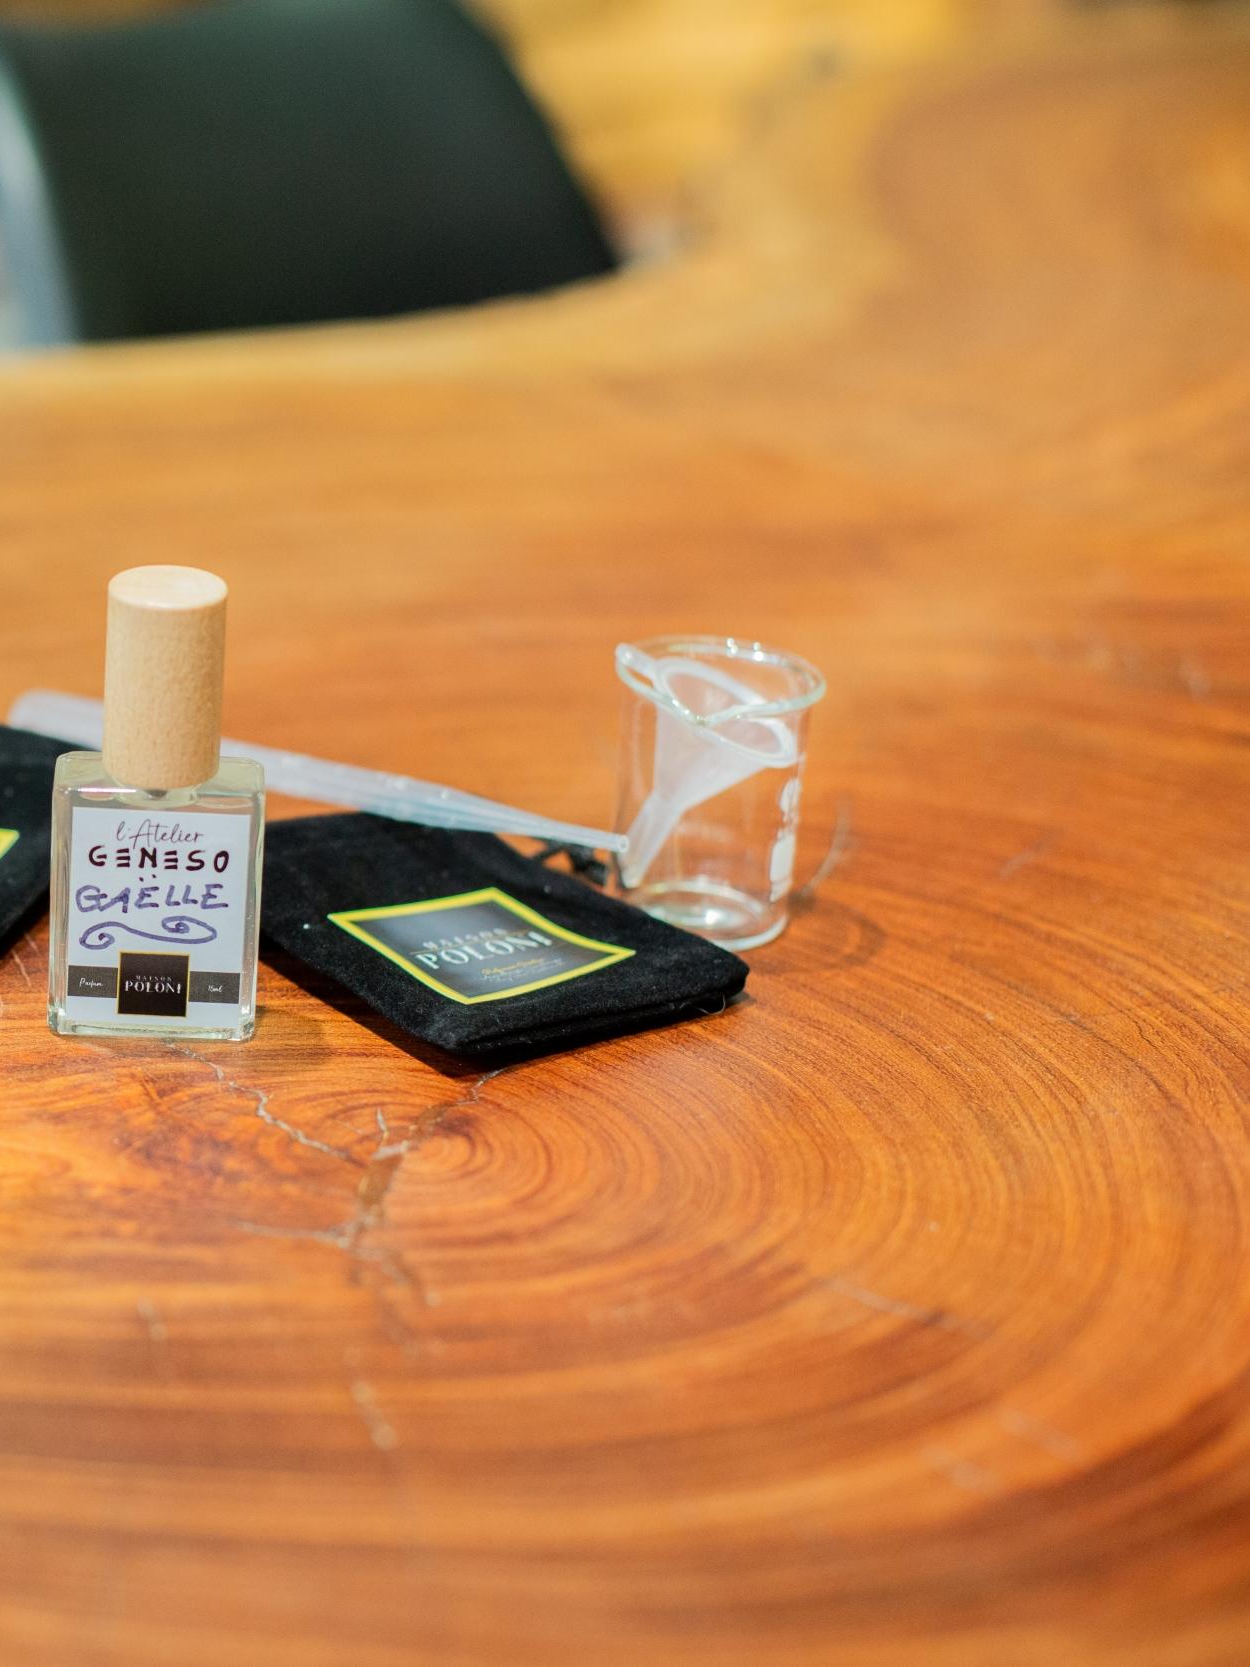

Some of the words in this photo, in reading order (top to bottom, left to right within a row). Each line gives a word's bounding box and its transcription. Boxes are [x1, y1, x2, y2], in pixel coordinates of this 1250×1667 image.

[89, 845, 230, 873] GENESO
[75, 873, 229, 914] GAËLLE
[415, 931, 552, 970] POLONI
[124, 980, 182, 994] POLONI
